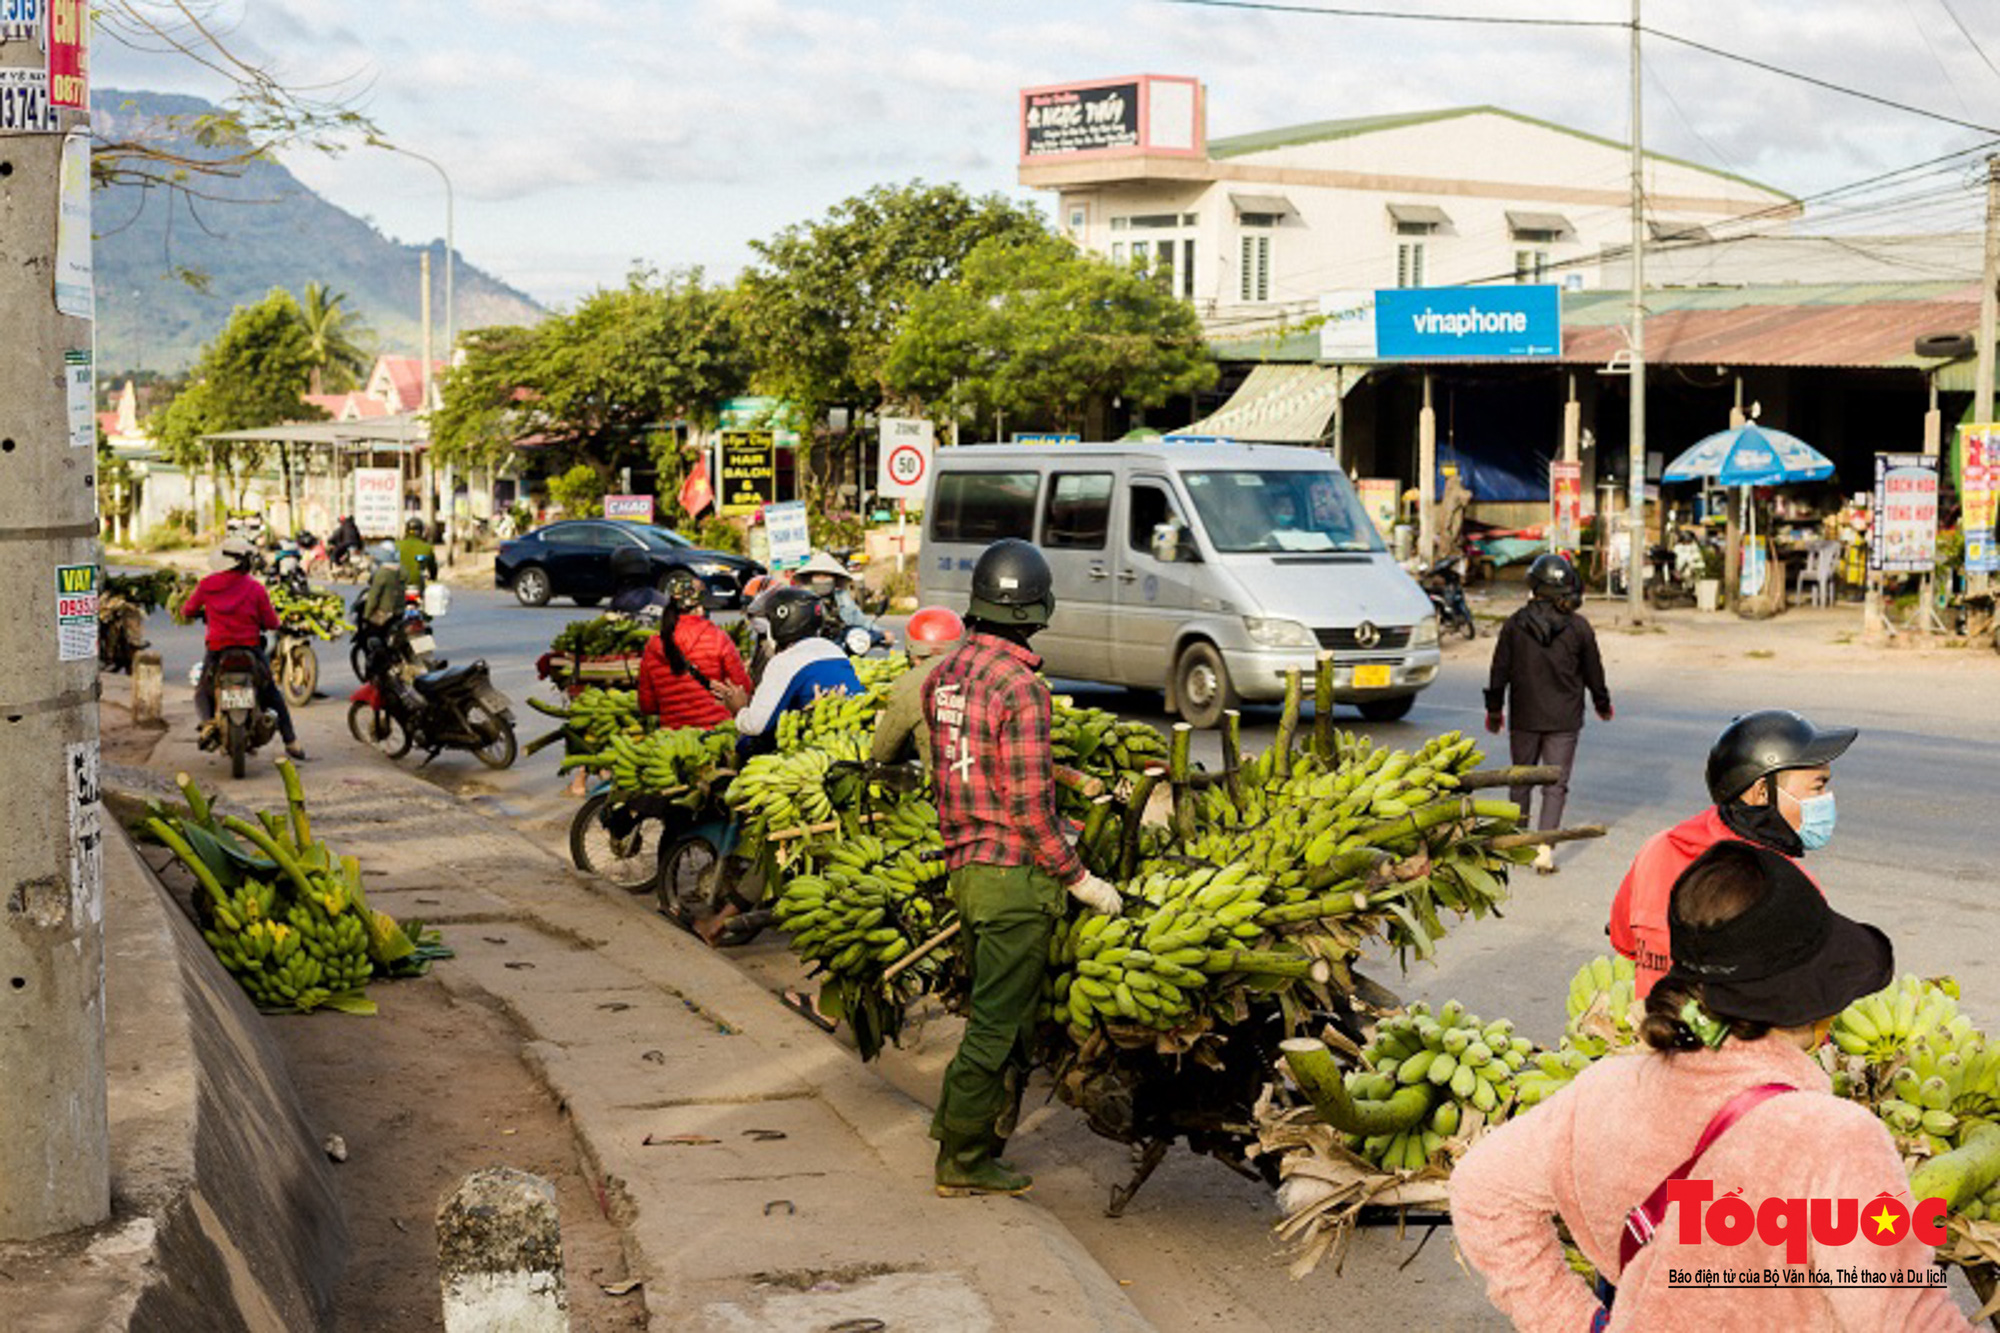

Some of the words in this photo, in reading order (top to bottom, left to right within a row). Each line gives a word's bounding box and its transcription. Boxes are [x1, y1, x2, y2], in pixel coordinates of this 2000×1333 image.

[1413, 307, 1527, 337] vinaphone
[895, 423, 920, 435] ZONE
[730, 454, 764, 466] HAIR
[899, 457, 915, 473] 50
[724, 466, 771, 478] SALON
